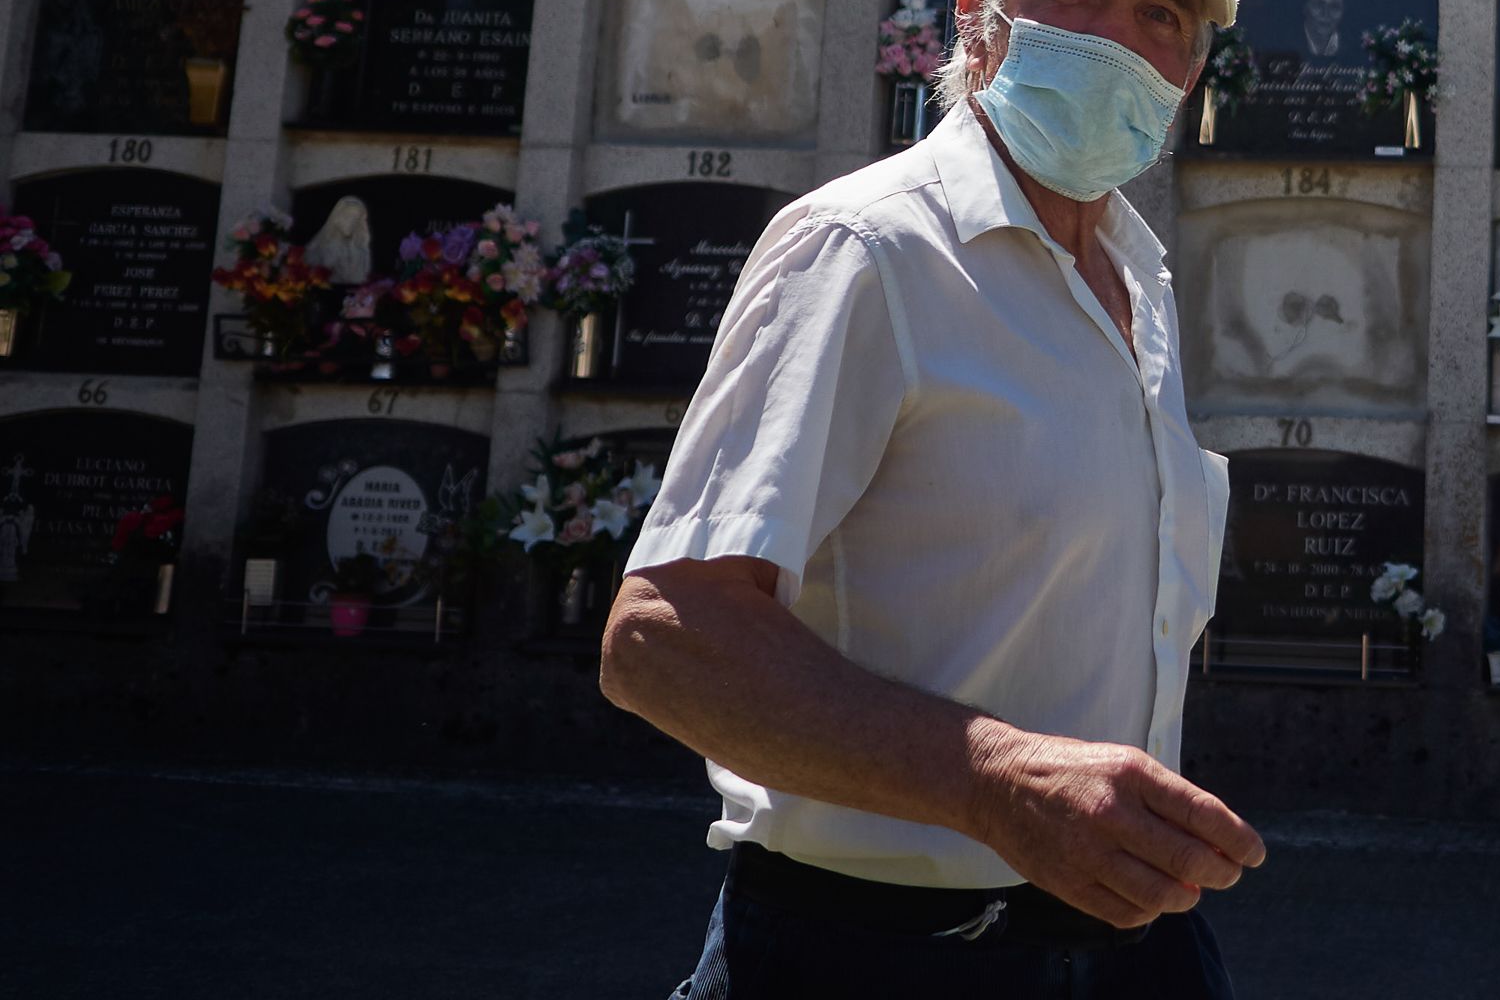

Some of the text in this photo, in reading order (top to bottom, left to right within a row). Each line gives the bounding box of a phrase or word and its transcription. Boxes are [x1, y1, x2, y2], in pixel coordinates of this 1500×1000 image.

[108, 139, 153, 162] 180
[392, 146, 432, 171] 181
[687, 150, 732, 176] 182
[1281, 168, 1330, 195] 184
[78, 379, 111, 405] 66
[367, 388, 400, 414] 67
[1278, 419, 1312, 446] 70
[1296, 510, 1365, 530] LOPEZ
